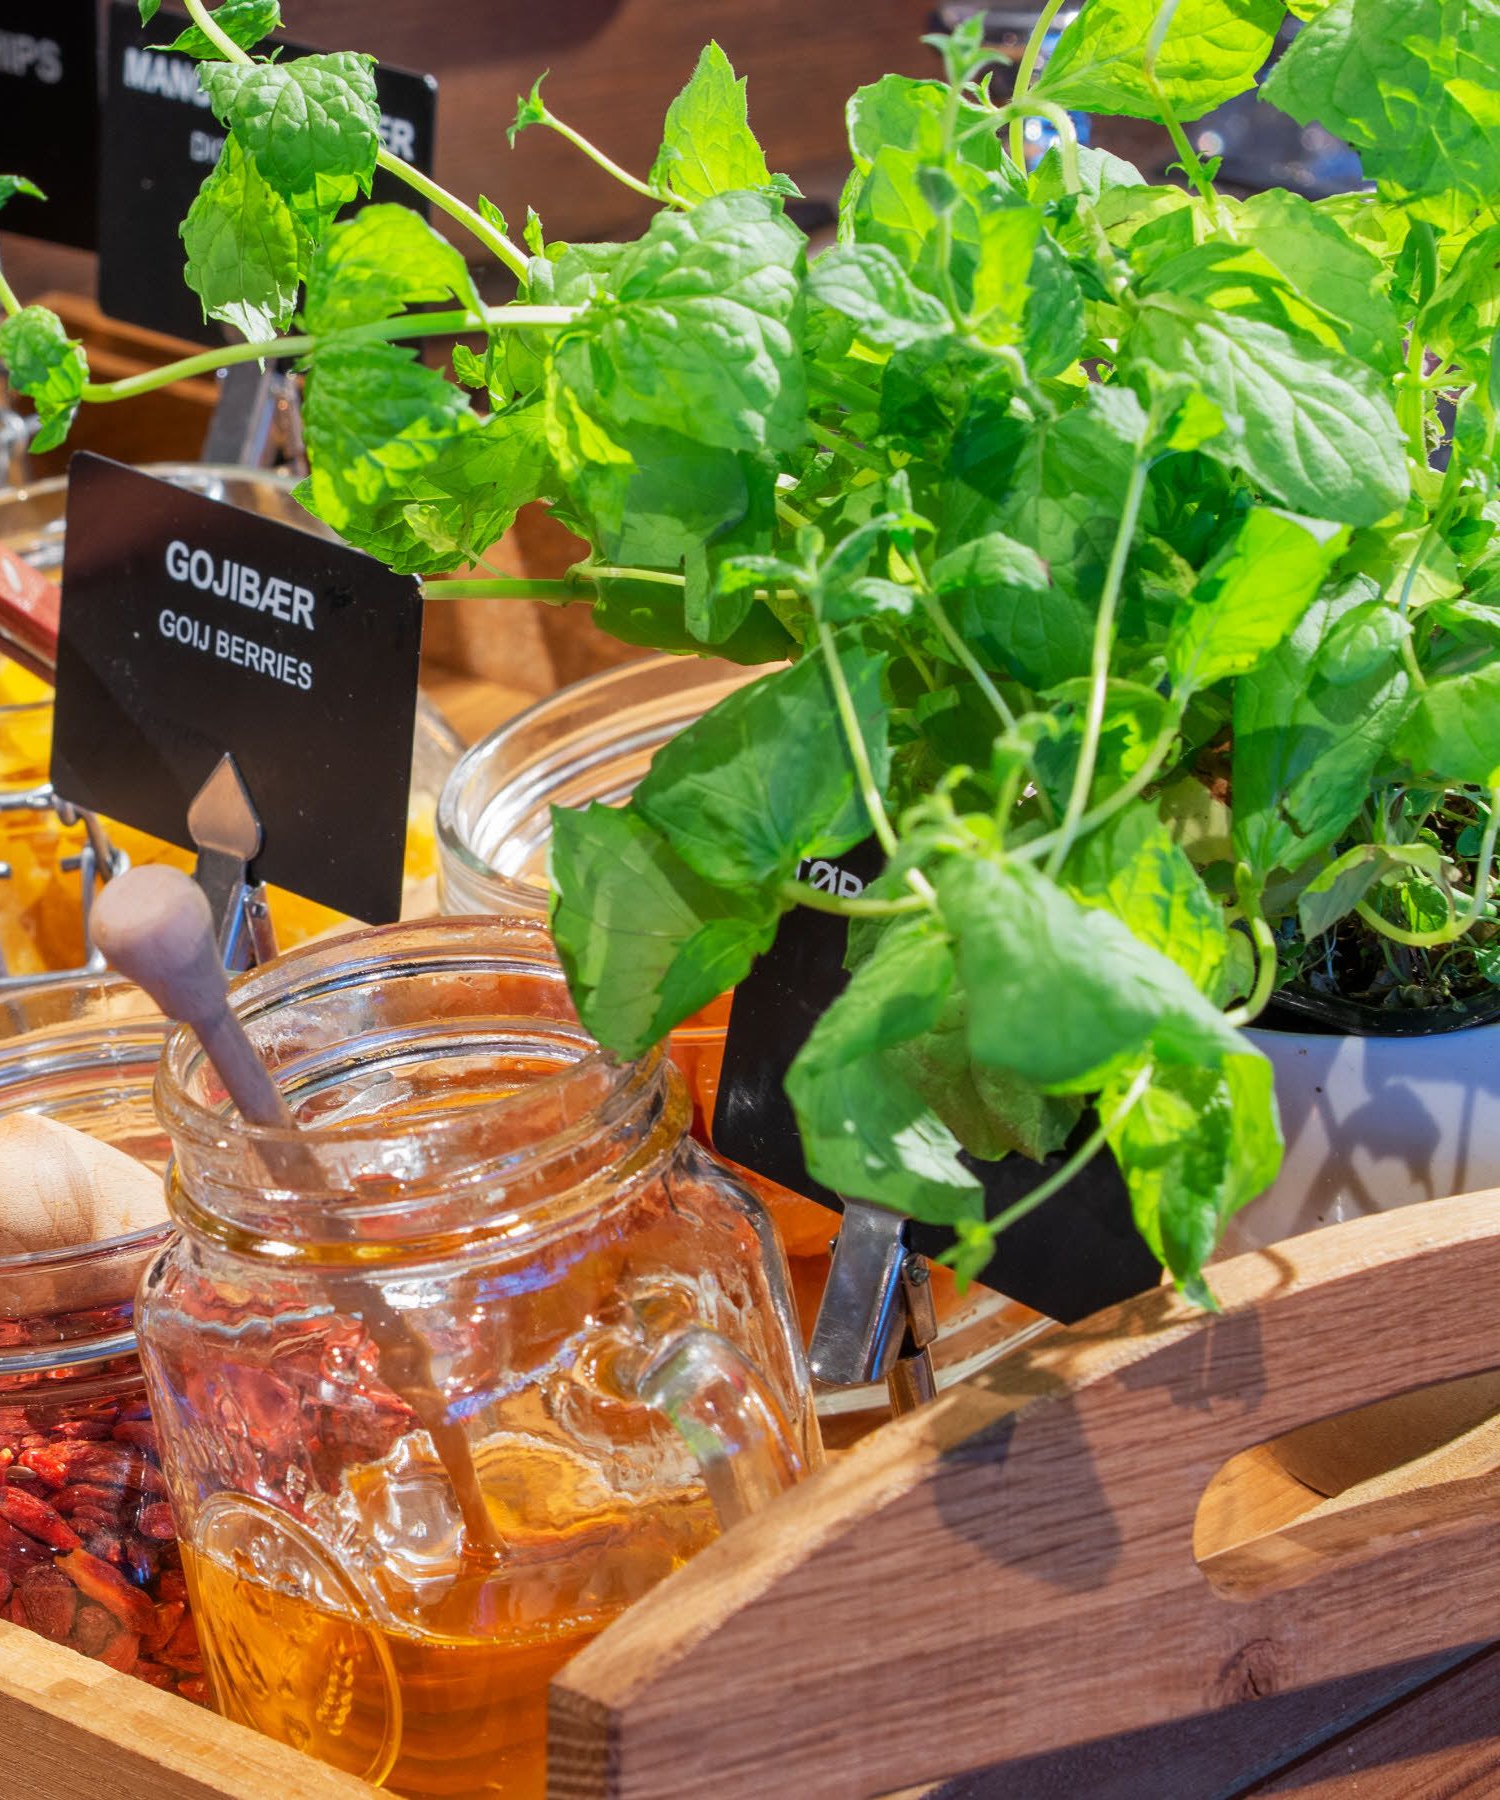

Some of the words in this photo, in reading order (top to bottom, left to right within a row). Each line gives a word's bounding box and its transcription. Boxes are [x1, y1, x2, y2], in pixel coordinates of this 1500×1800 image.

[165, 539, 315, 631] GOJIBÆR
[158, 608, 211, 651] GOIJ
[214, 629, 313, 690] BERRIES
